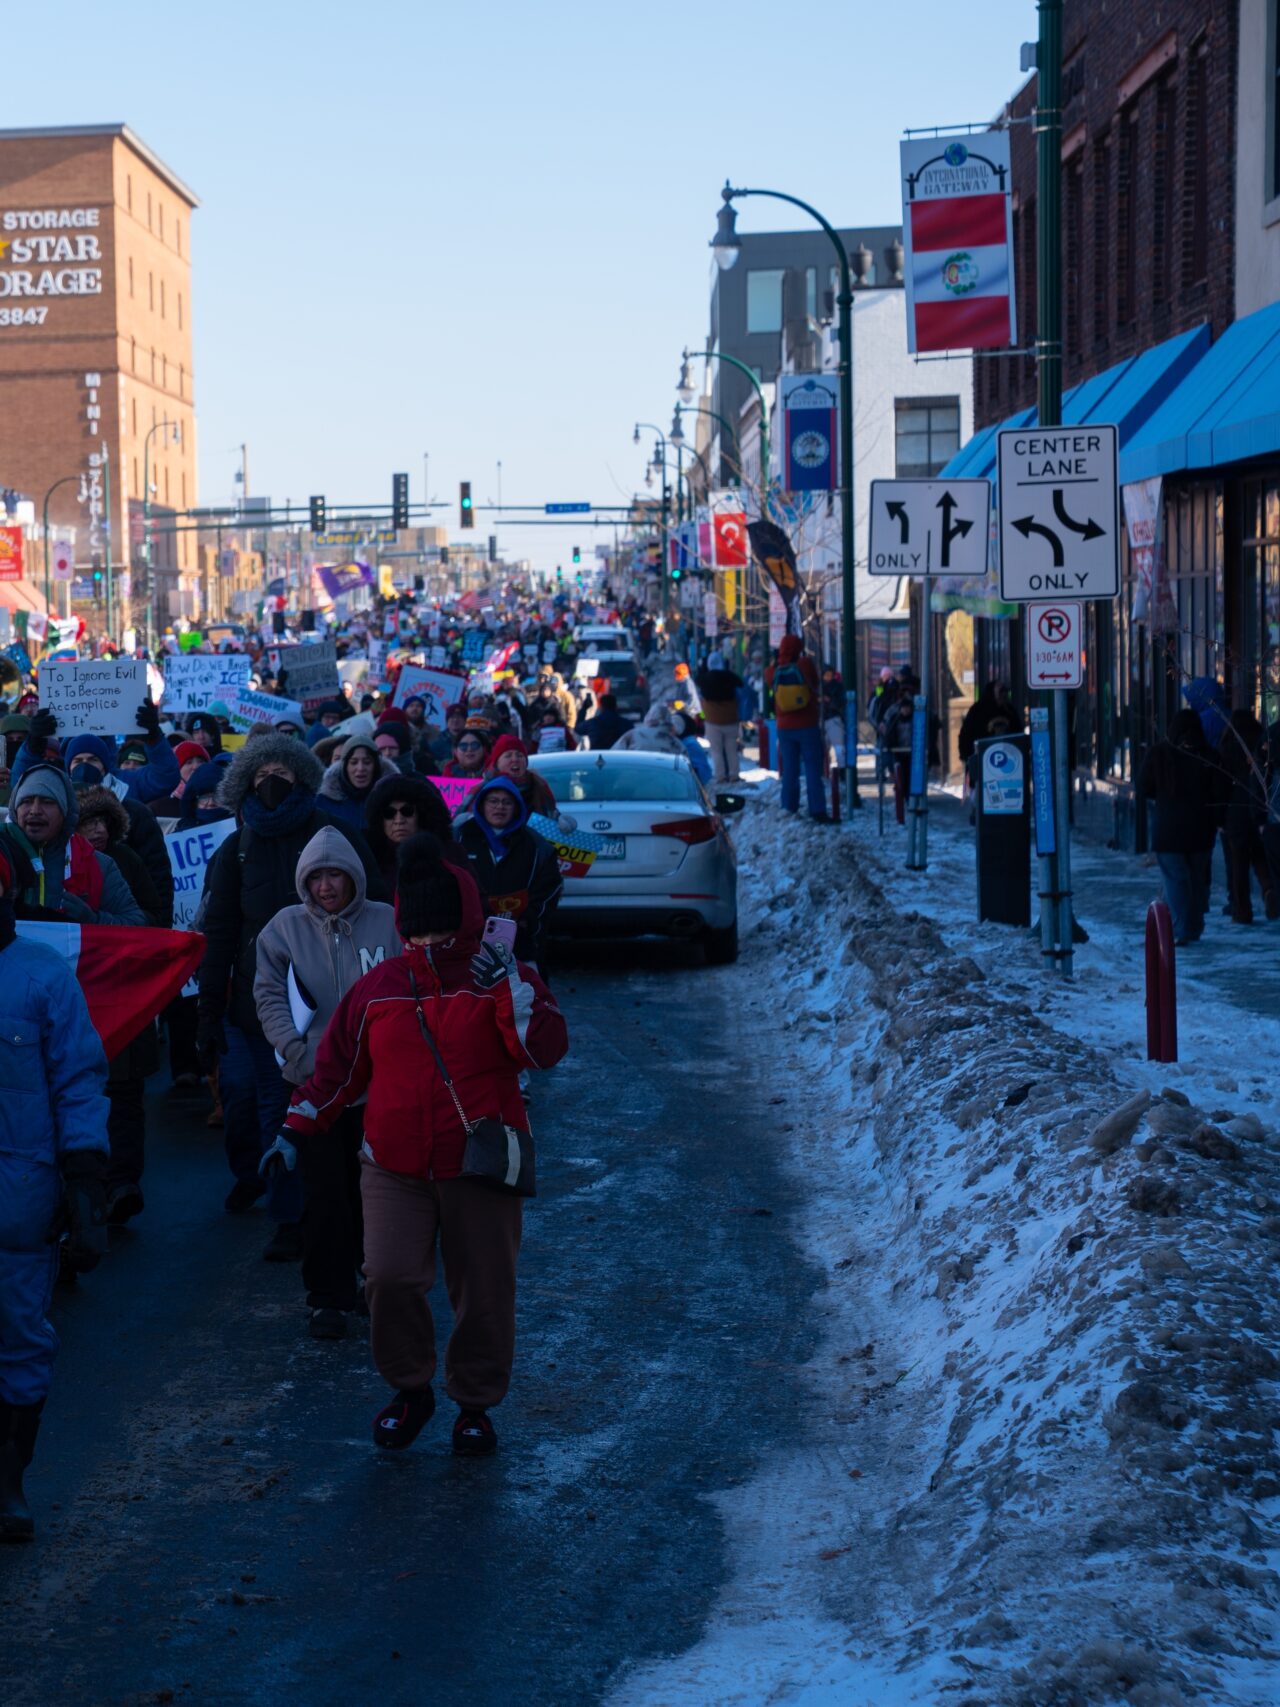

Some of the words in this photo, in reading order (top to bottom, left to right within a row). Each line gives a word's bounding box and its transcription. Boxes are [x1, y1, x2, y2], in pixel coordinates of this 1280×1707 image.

[924, 165, 989, 184] INTERNATIONAL
[924, 179, 989, 195] GATEWAY
[4, 208, 100, 230] STORAGE
[11, 235, 102, 263] STAR
[1014, 436, 1101, 456] CENTER
[1028, 459, 1087, 477] LANE
[875, 553, 922, 568] ONLY
[1029, 572, 1090, 591] ONLY
[73, 667, 111, 684] Ignore
[115, 666, 136, 680] Evil
[219, 671, 246, 686] ICE
[47, 687, 60, 698] Is
[64, 685, 76, 697] To
[48, 699, 119, 712] Accomplice
[171, 831, 214, 870] ICE
[559, 845, 591, 861] OUT
[172, 872, 198, 893] OUT
